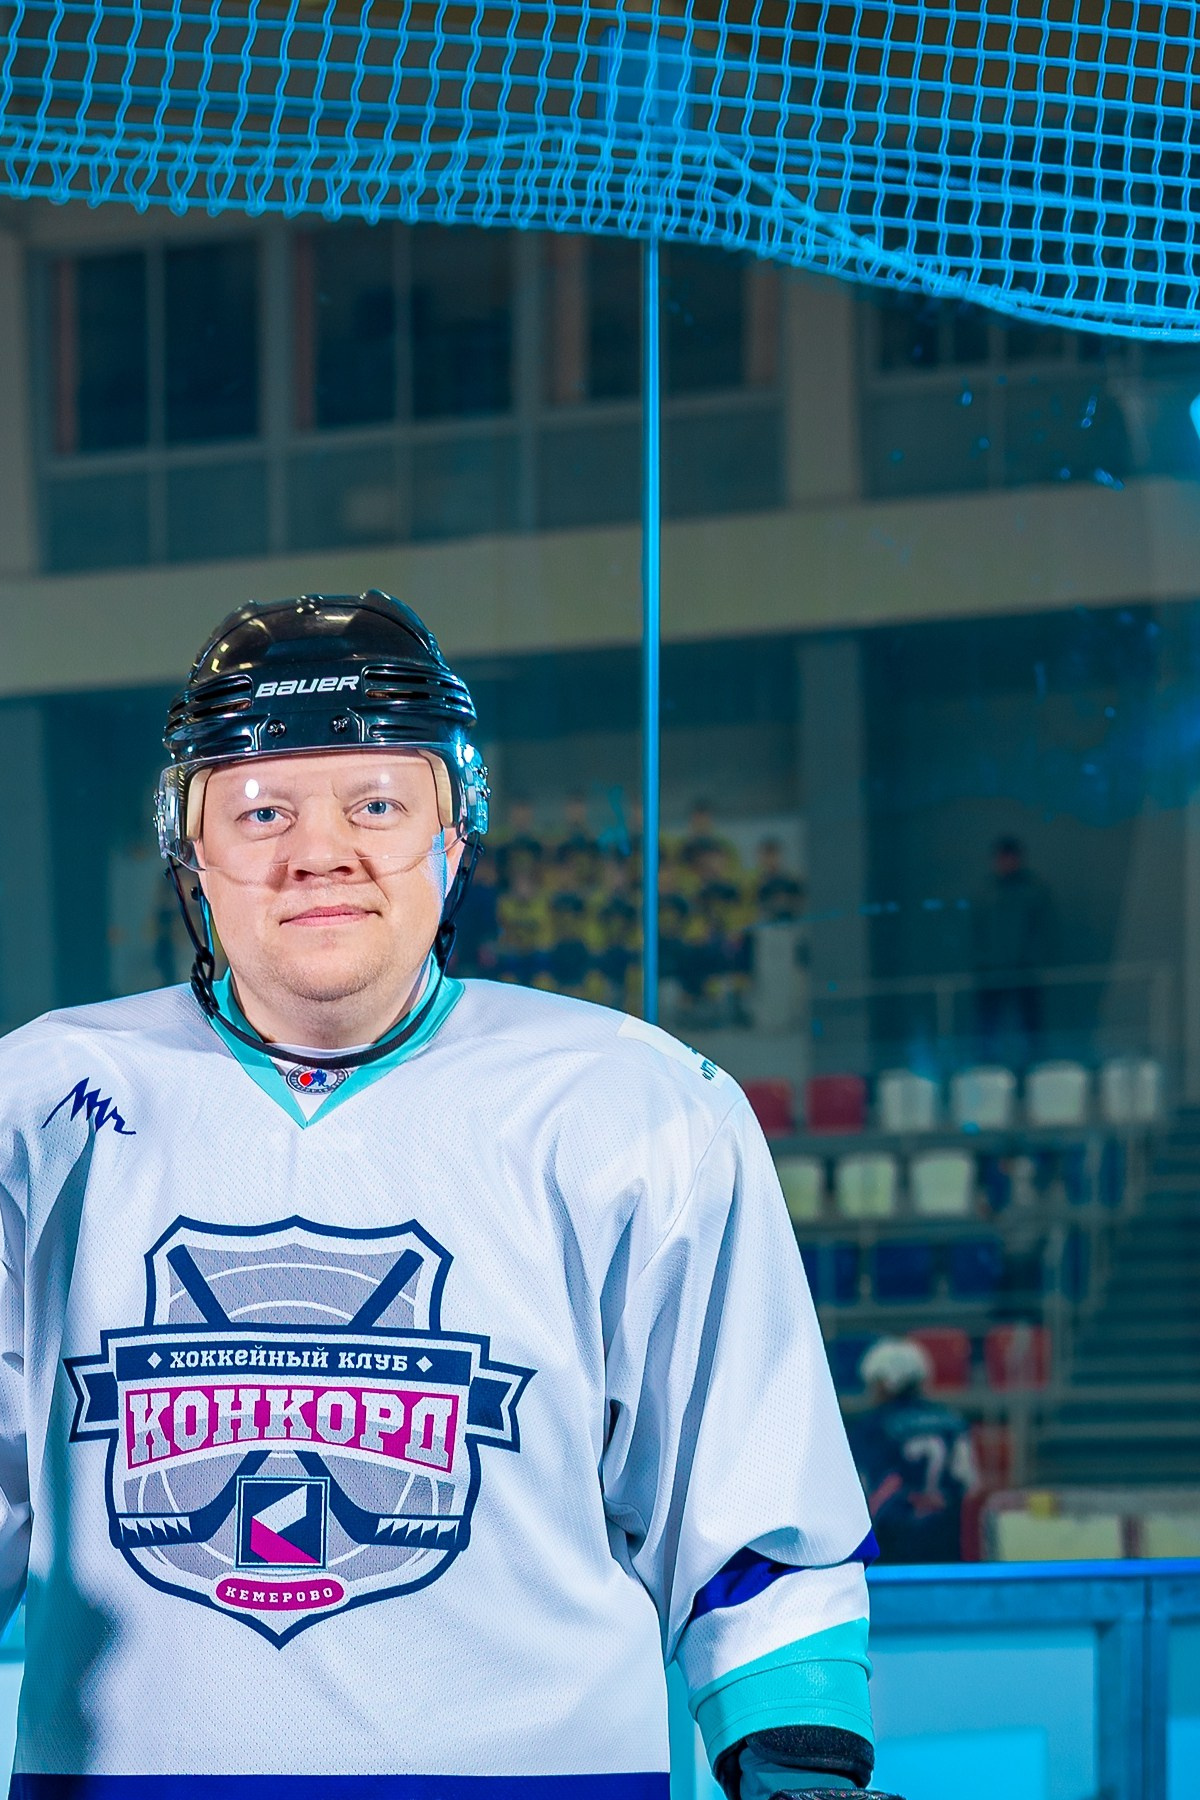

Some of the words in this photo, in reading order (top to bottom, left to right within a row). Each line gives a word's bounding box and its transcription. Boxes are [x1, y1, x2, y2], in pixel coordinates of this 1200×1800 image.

[255, 675, 360, 698] BAUER
[129, 1388, 453, 1467] КОНКОРД
[225, 1585, 335, 1603] КЕМЕРОВО
